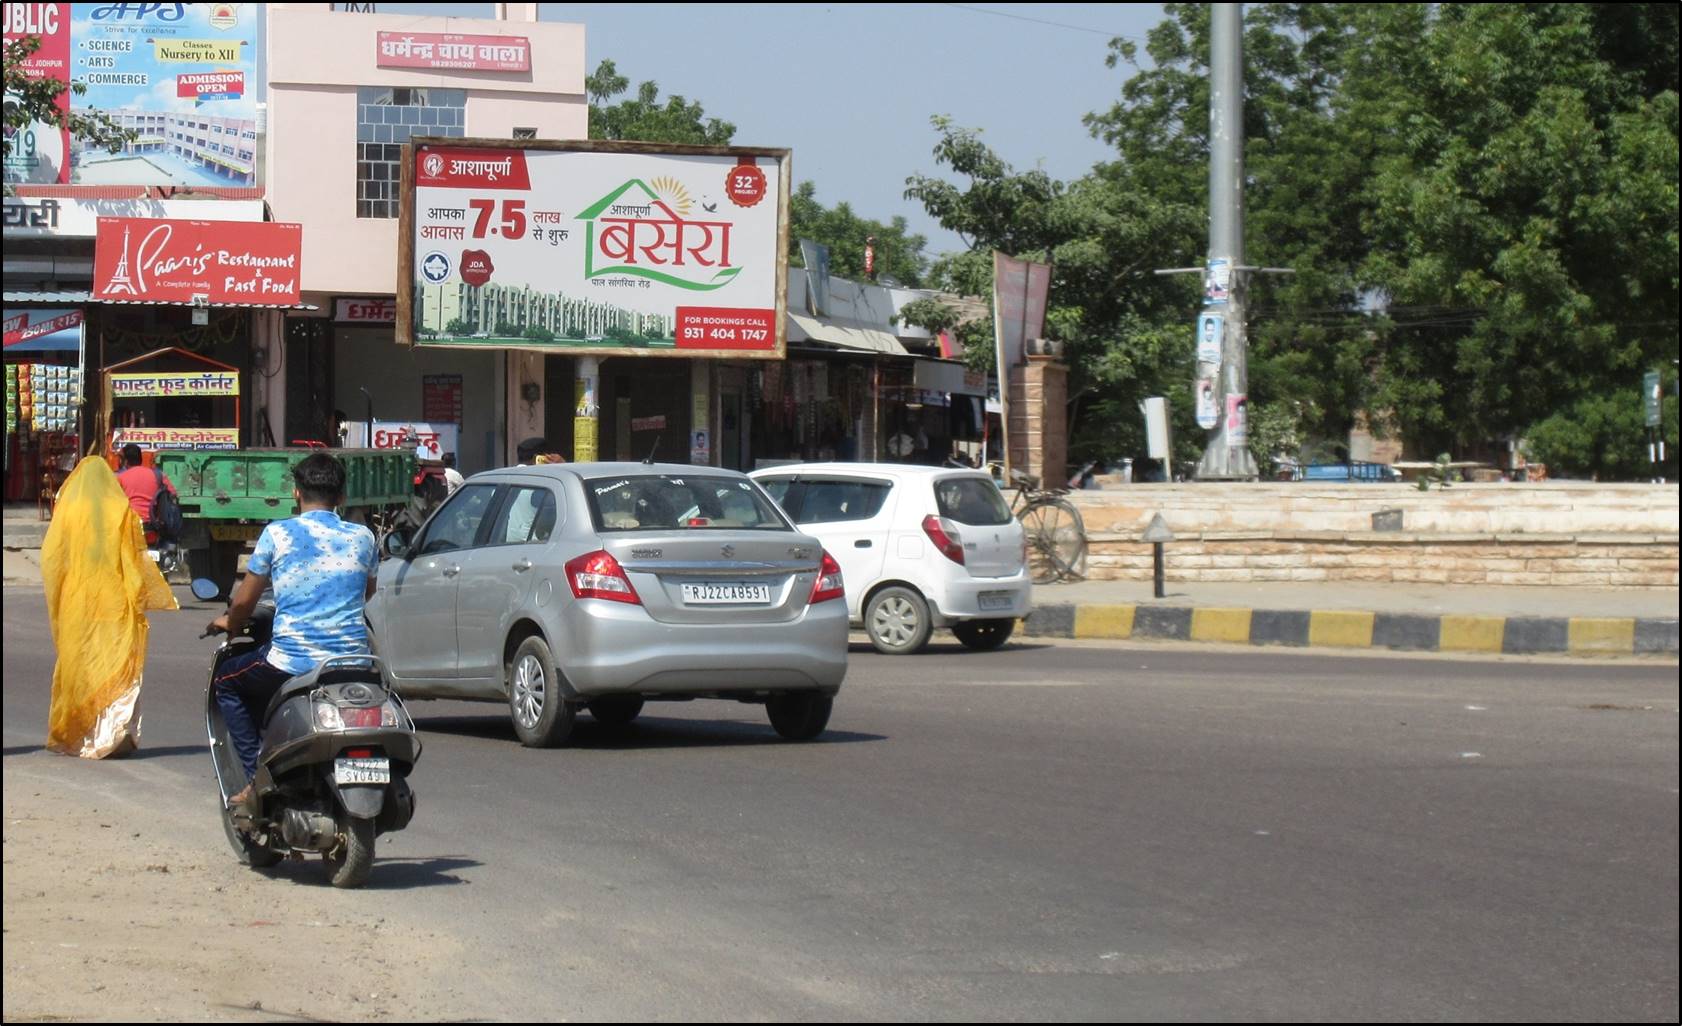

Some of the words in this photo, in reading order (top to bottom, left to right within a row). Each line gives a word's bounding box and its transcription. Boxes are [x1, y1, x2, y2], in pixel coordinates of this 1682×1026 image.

[88, 41, 131, 51] SCIENCE
[160, 48, 201, 61] Nursery
[205, 50, 215, 60] to
[219, 49, 234, 60] XII
[479, 45, 526, 62] वाला
[36, 60, 62, 68] JODHPUR
[88, 57, 114, 67] ARTS
[89, 74, 147, 84] COMMERCE
[180, 74, 243, 84] ADMISSION
[196, 84, 227, 93] OPEN
[449, 157, 511, 180] आशापूर्णा
[427, 207, 465, 220] आपका
[610, 203, 651, 218] आशापूर्णा
[469, 199, 527, 240] 7.5
[533, 211, 561, 225] लाख
[420, 225, 465, 241] आवास
[533, 226, 543, 241] से
[600, 200, 733, 267] बसेरा
[218, 250, 295, 268] Restaurant
[255, 268, 263, 277] &
[192, 281, 211, 290] Family
[225, 277, 256, 293] Fast
[262, 278, 294, 294] Food
[591, 278, 606, 287] पाल
[638, 278, 651, 289] रोड
[685, 316, 701, 324] FOR
[703, 317, 745, 325] BOOKINGS
[747, 318, 767, 326] CALL
[684, 328, 704, 339] 931
[710, 328, 736, 340] 404
[741, 329, 767, 340] 1747
[112, 378, 156, 391] फास्ट
[158, 378, 186, 394] फूड
[188, 374, 235, 389] कॉर्नर
[692, 585, 767, 600] RJ22CA8591
